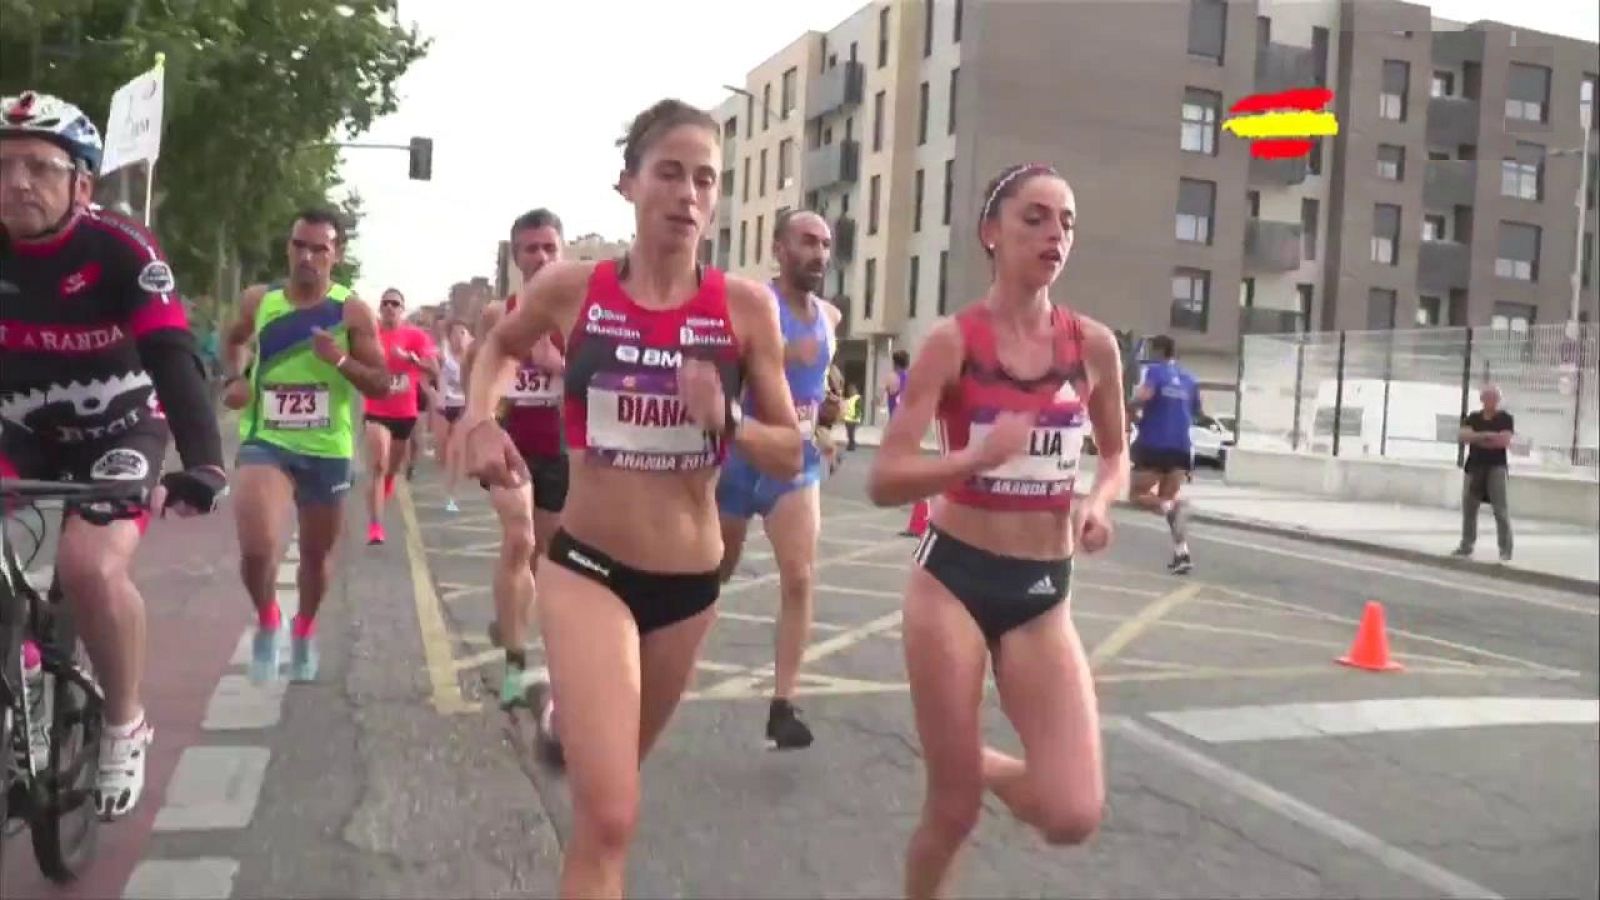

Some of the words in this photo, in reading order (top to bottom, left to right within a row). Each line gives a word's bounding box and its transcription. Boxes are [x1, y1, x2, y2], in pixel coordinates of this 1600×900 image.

[22, 324, 124, 351] ARANDA
[515, 370, 551, 392] 357
[275, 394, 316, 415] 723
[1029, 429, 1062, 456] LIA
